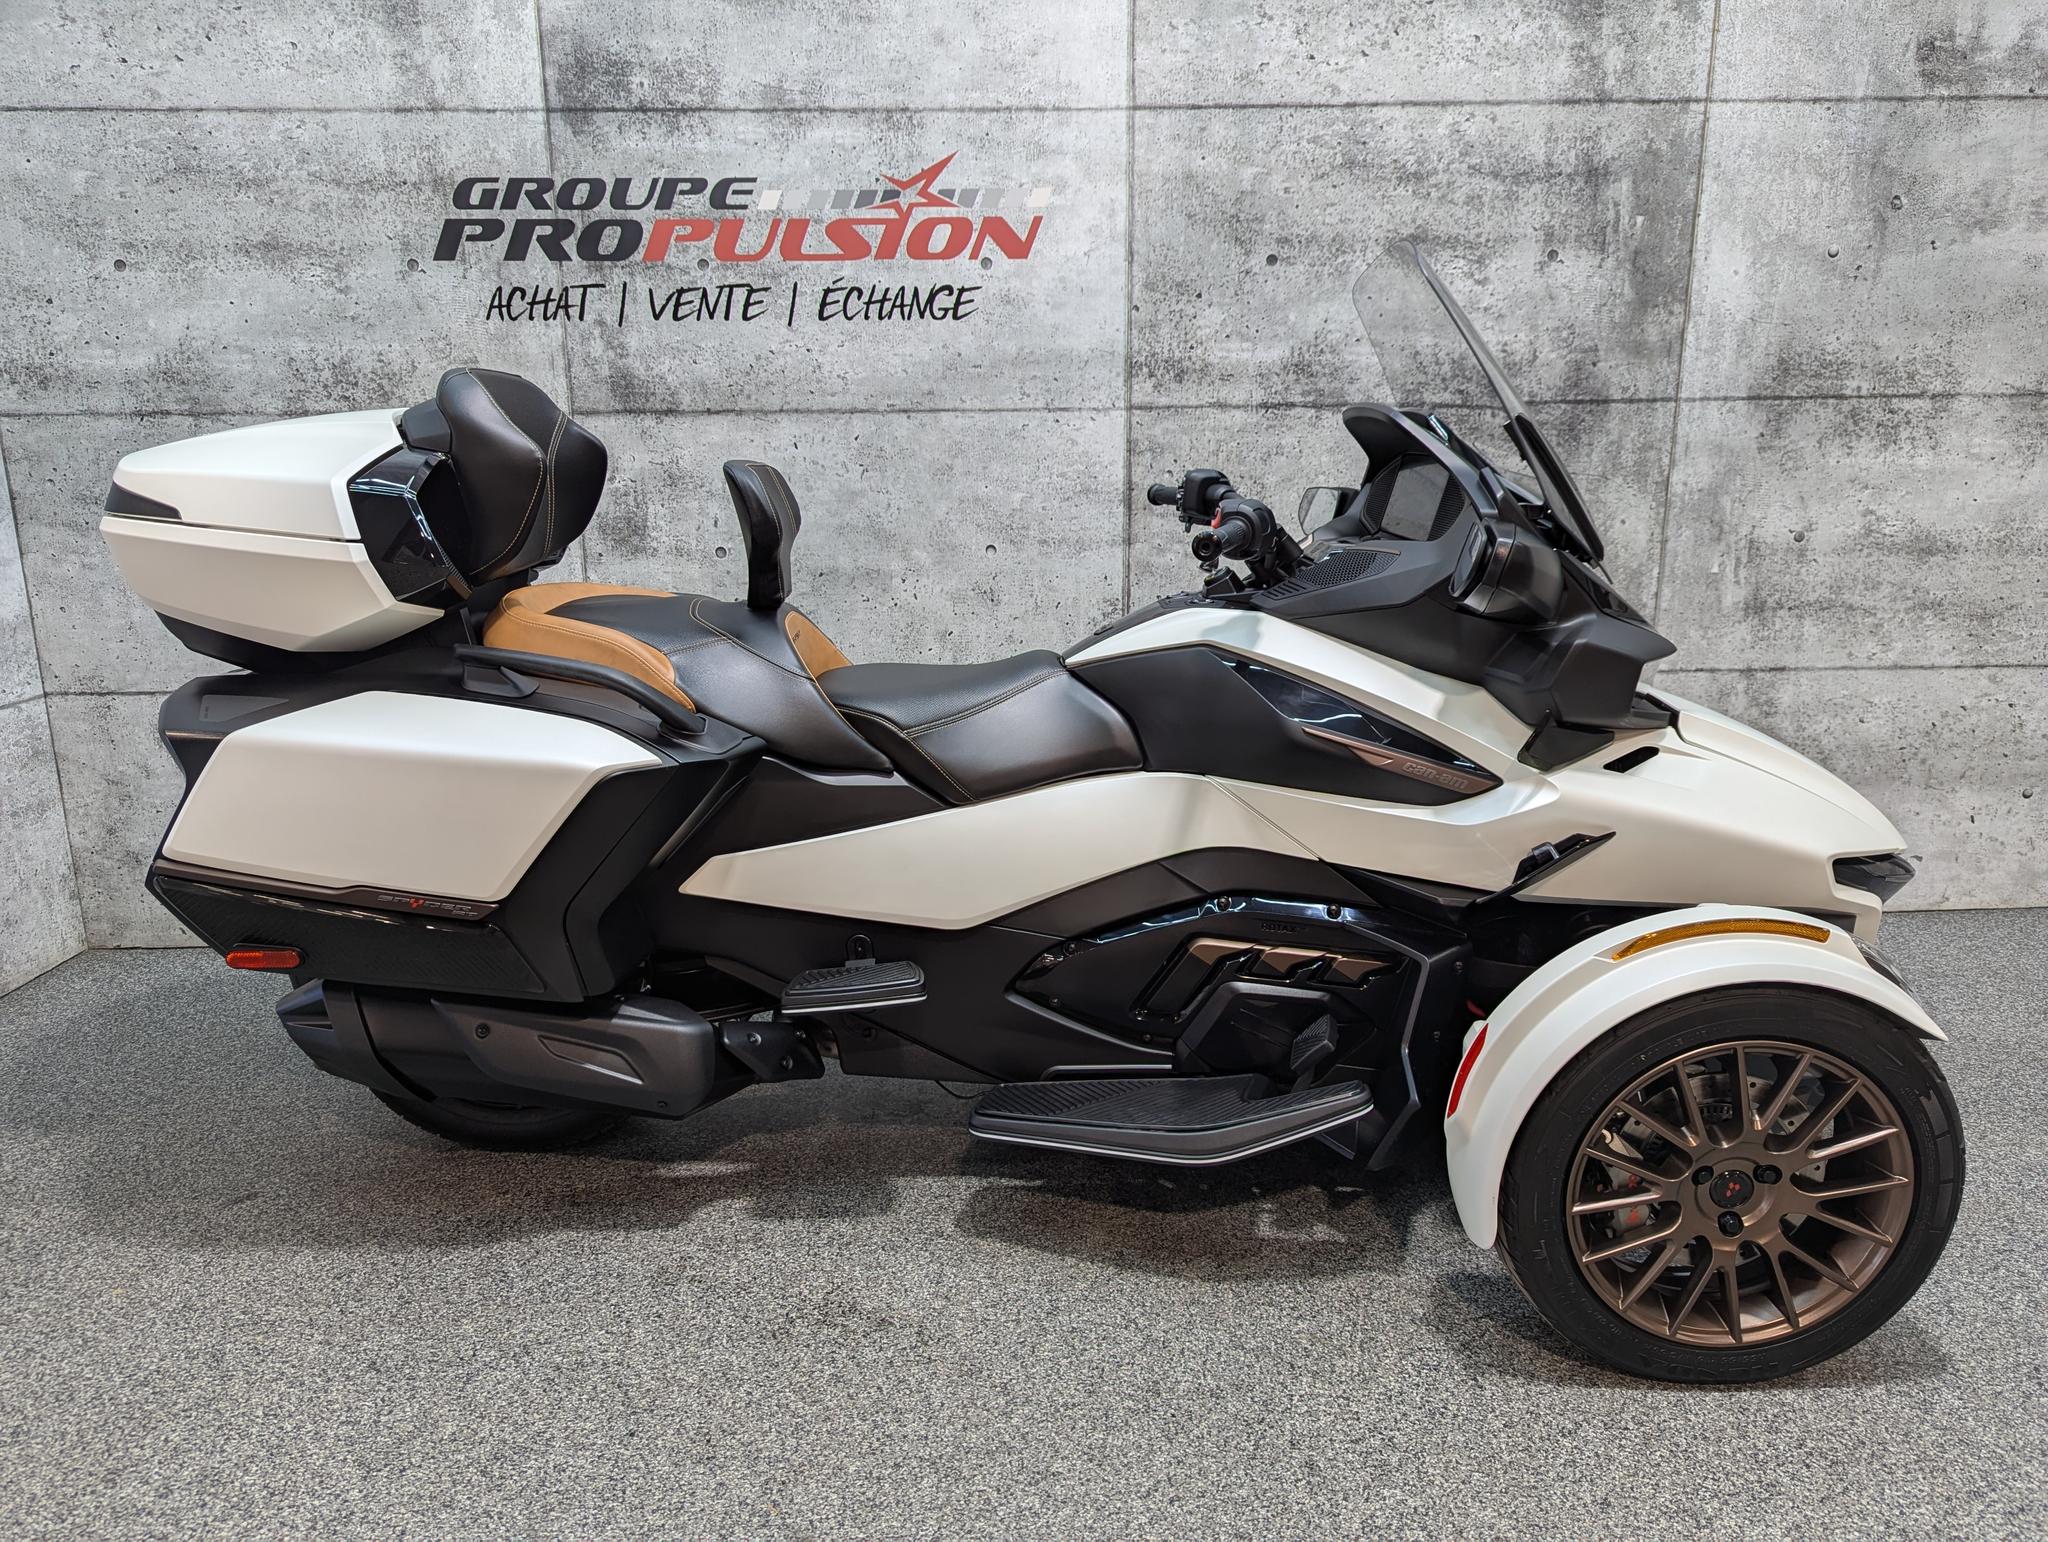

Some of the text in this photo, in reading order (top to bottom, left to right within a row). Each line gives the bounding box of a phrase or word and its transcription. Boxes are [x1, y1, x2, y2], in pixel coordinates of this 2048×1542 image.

[453, 176, 758, 211] GROUPE
[433, 214, 1044, 263] PROPULSION
[485, 284, 606, 322] ACHAT
[649, 282, 772, 322] VENTE
[817, 276, 982, 322] ÉCHANGE
